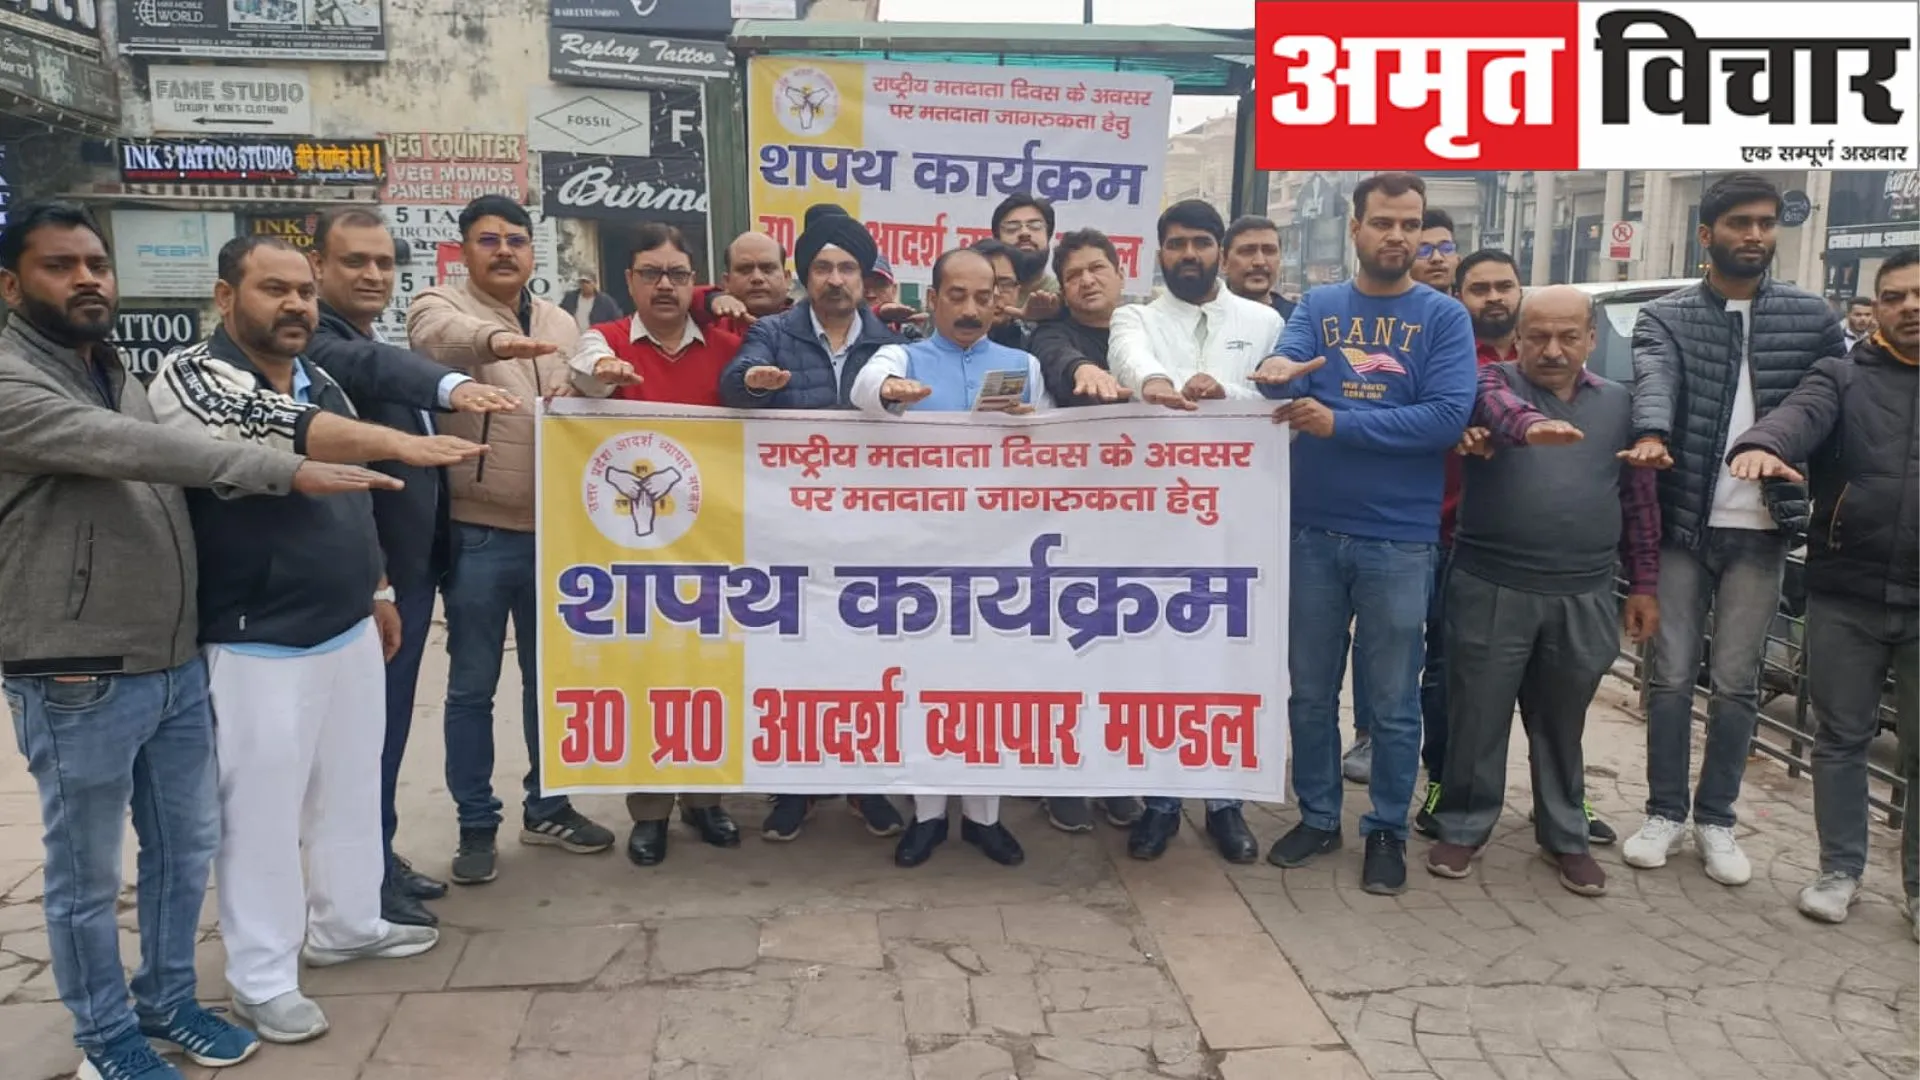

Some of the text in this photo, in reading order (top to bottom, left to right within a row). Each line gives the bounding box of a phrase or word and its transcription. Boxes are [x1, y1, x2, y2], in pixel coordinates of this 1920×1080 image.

[158, 10, 204, 23] WORLD
[560, 33, 640, 63] Replay
[649, 40, 716, 64] Tattoo
[155, 80, 304, 104] FAME STUDIO
[872, 72, 1153, 107] राष्ट्रीय मतदाता दिवस के अवसर
[567, 115, 612, 128] FOSSIL
[671, 109, 696, 143] F
[888, 103, 914, 121] पर
[918, 104, 990, 124] मतदाता
[1101, 110, 1131, 140] हेतु
[123, 145, 162, 169] INK
[384, 134, 521, 161] VEG COUNTER
[394, 166, 434, 182] VEG
[440, 167, 514, 183] MOMOS
[759, 139, 1149, 205] शपथ कार्यक्रम
[387, 184, 453, 200] PANEER
[255, 219, 302, 234] INK
[396, 207, 409, 223] 5
[401, 272, 413, 292] 5
[1322, 316, 1422, 352] GANT
[759, 434, 1254, 477] राष्ट्रीय मतदाता दिवस के अवसर
[790, 478, 1219, 526] पर मतदाता जागरुकता हेतु
[557, 533, 1258, 650] शपथ कार्यक्रम
[751, 667, 902, 766] आदर्श
[918, 690, 1083, 767] व्यापार
[1098, 691, 1263, 769] मण्डल
